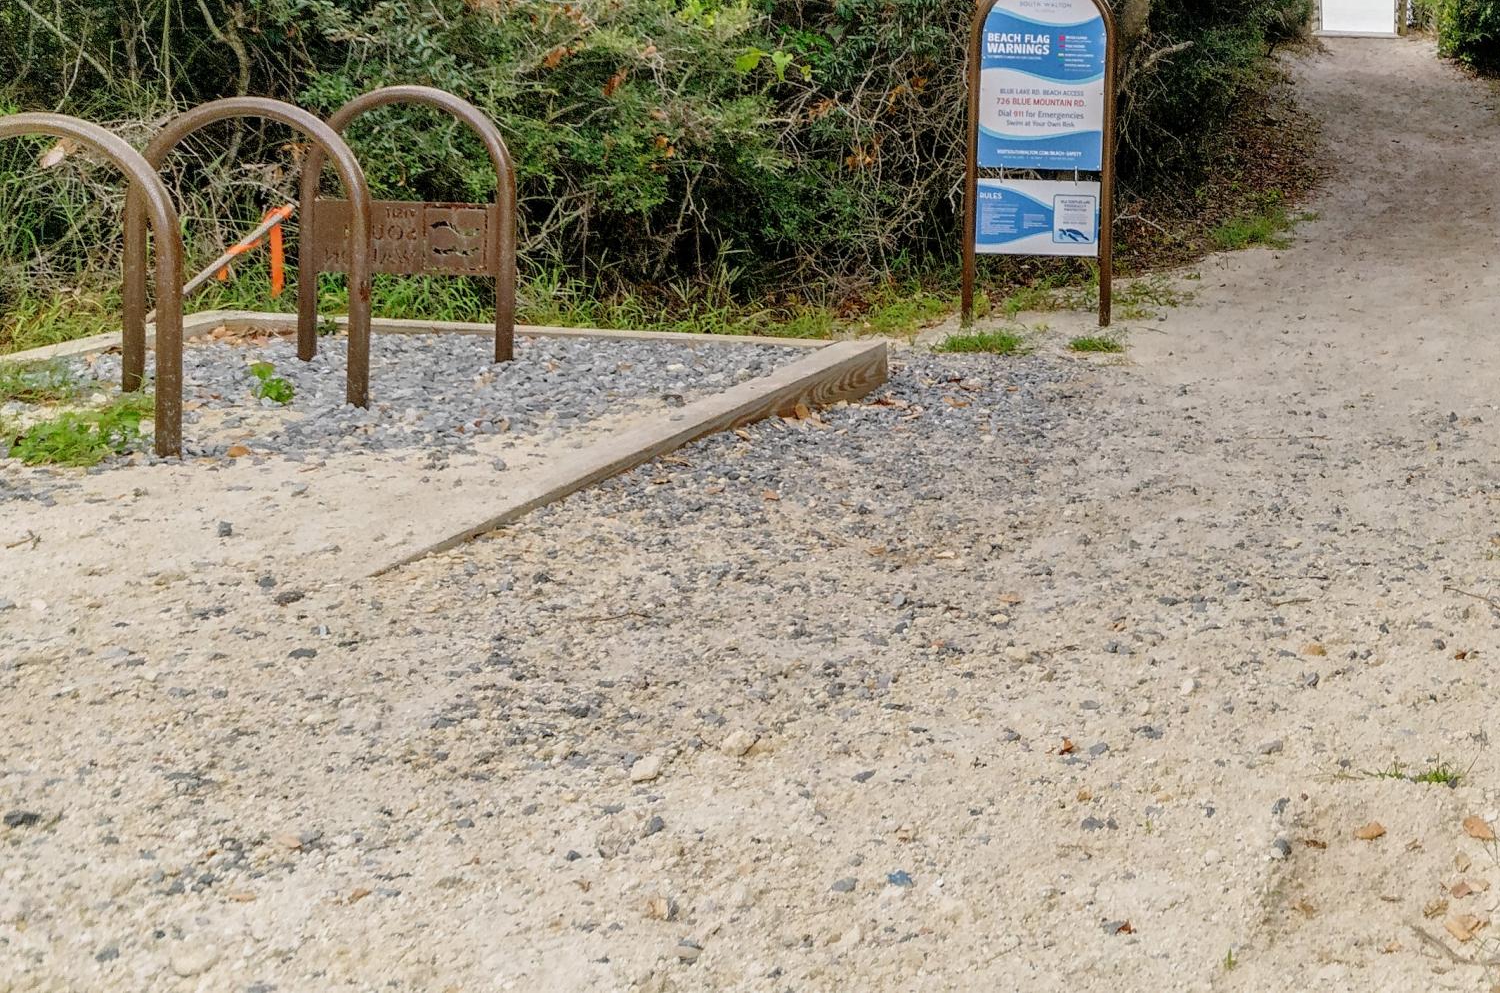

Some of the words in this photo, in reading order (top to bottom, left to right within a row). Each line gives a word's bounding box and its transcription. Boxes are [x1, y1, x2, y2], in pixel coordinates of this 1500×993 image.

[987, 33, 1021, 43] BEACH
[1025, 34, 1050, 44] FLAG
[987, 43, 1050, 55] WARNINGS
[1012, 98, 1031, 106] BLUE
[1033, 98, 1072, 107] MOUNTAIN
[1073, 99, 1087, 107] RD.
[998, 109, 1012, 117] Dial
[1025, 110, 1036, 118] for
[1038, 111, 1084, 120] Emergencies
[979, 192, 1002, 200] RULES
